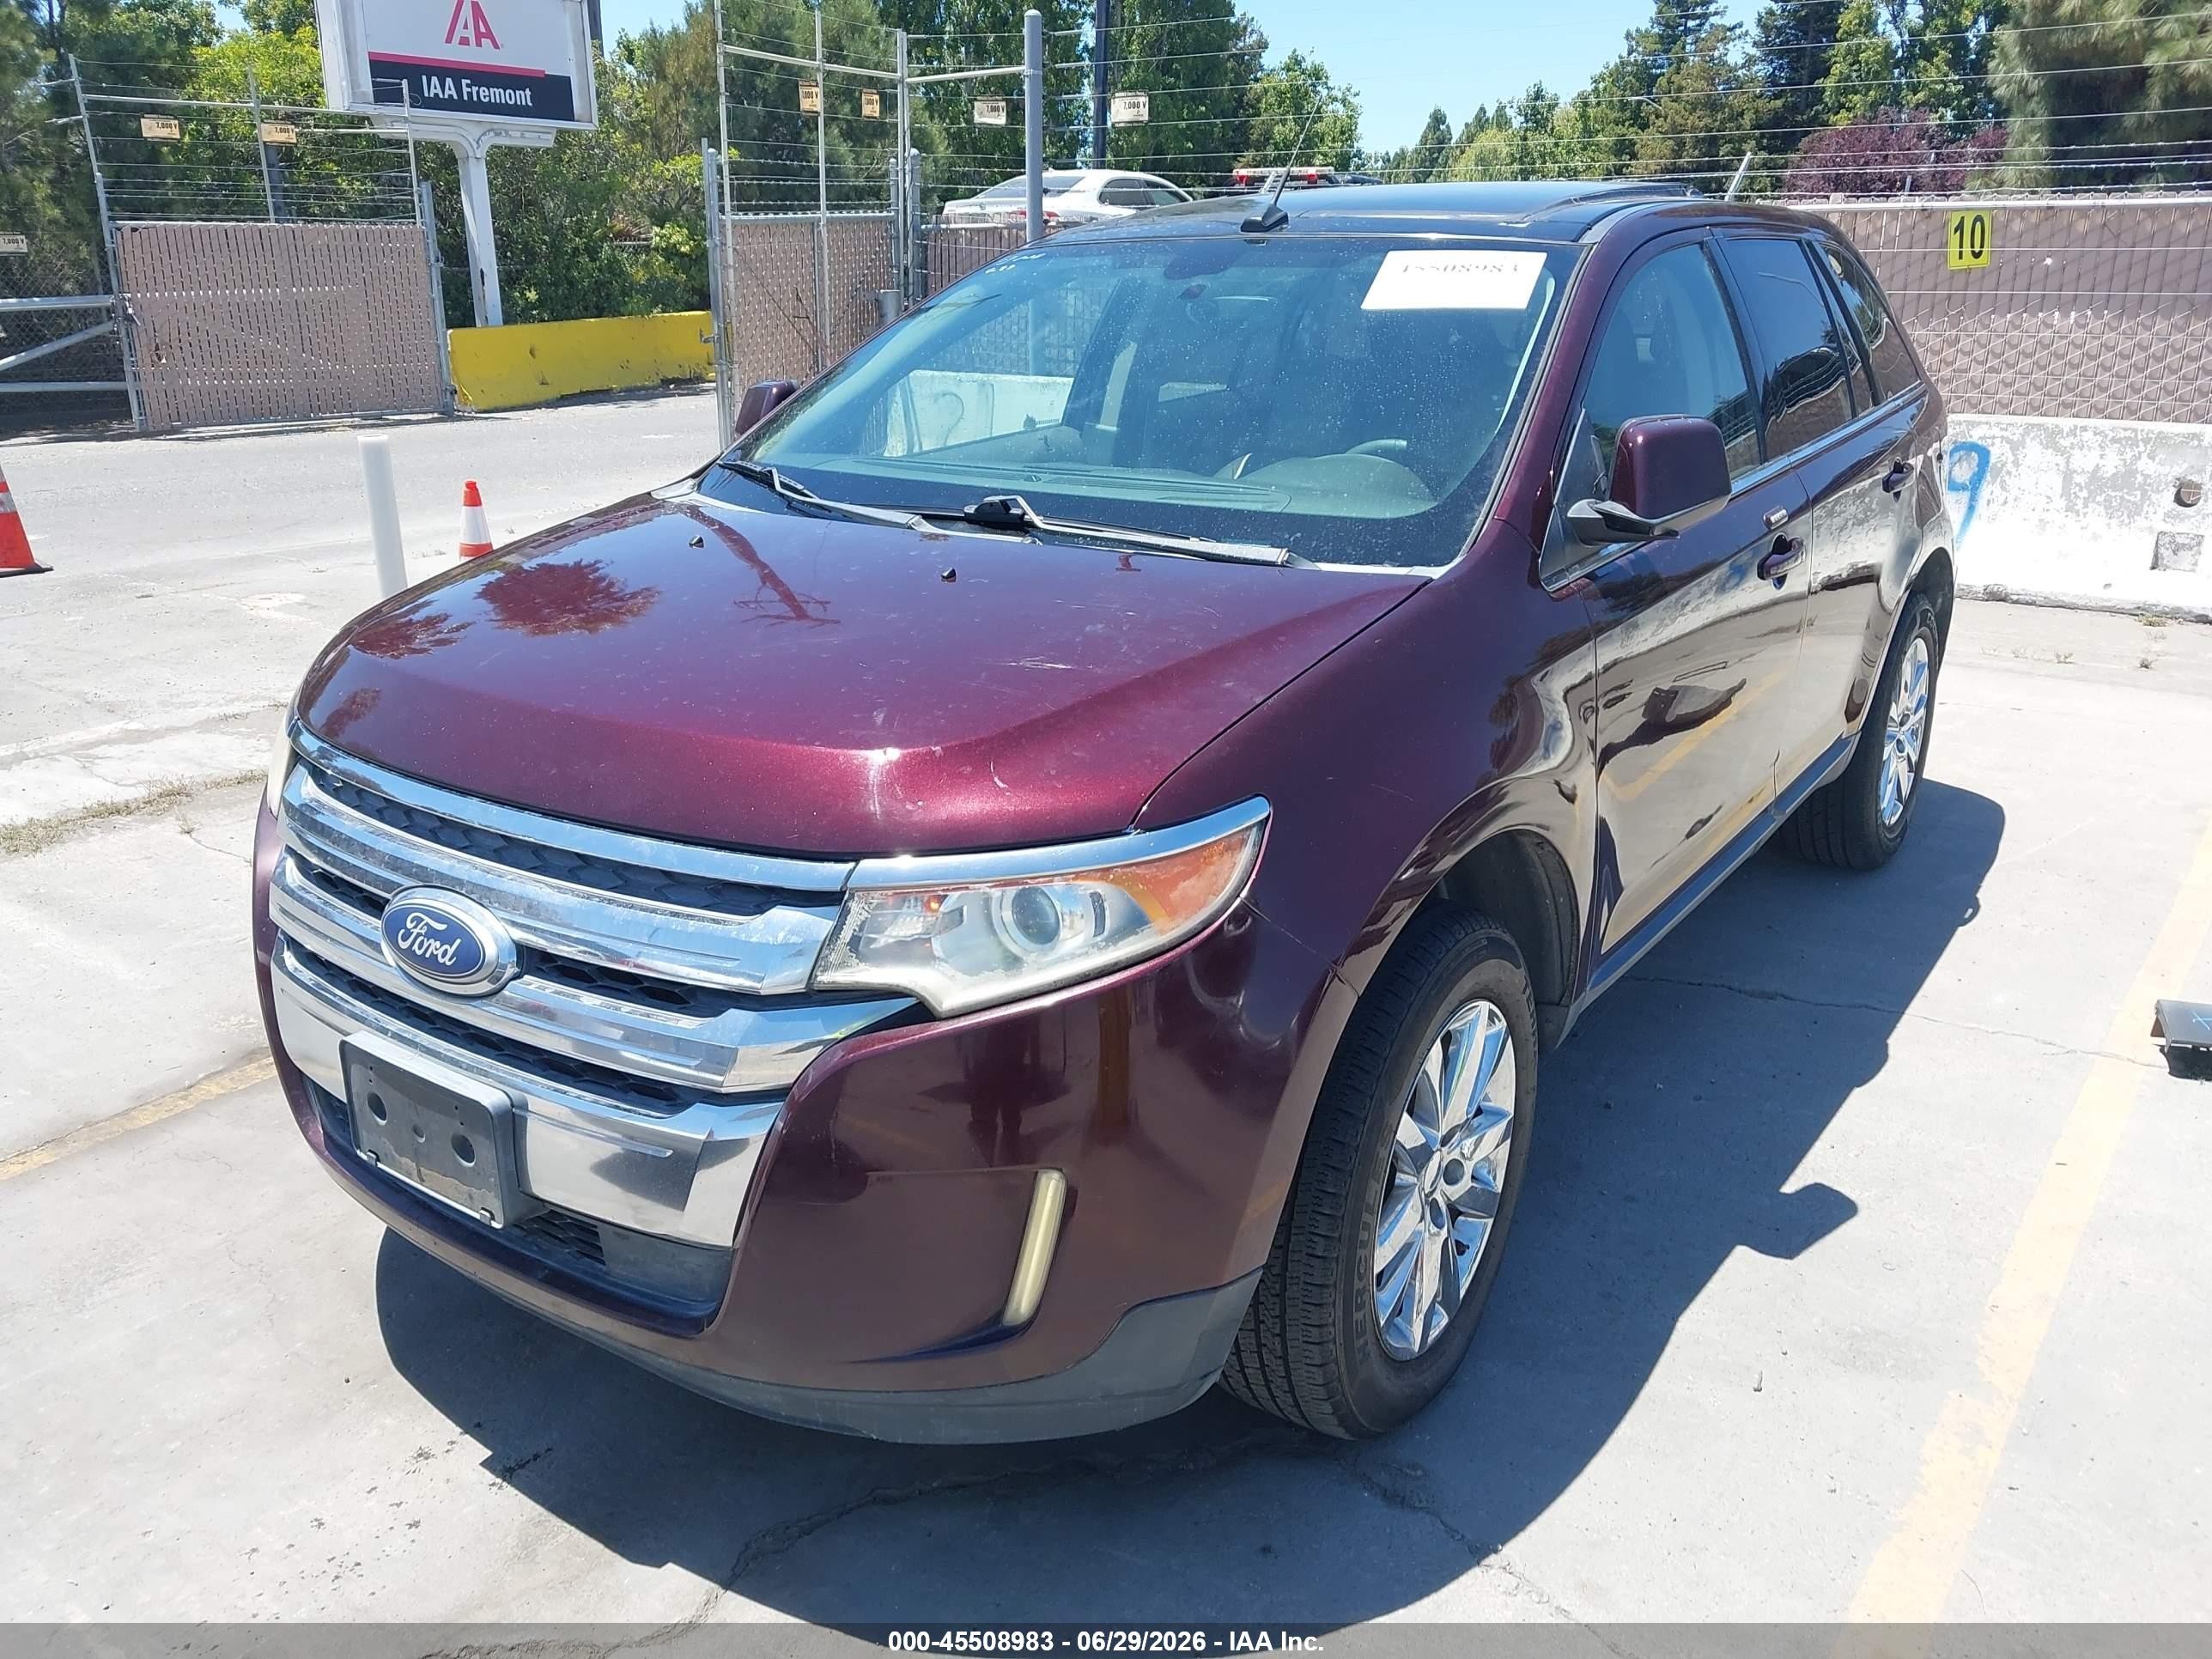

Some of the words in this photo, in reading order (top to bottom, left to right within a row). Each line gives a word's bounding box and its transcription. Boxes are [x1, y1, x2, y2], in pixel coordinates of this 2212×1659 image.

[422, 75, 458, 100] IAA
[461, 79, 533, 106] Fremont
[1122, 101, 1141, 110] 7,000
[1142, 100, 1147, 109] V
[1954, 214, 1985, 260] 10
[1948, 441, 1991, 550] 9
[398, 912, 462, 966] Ford
[1354, 1124, 1394, 1365] HERCULES
